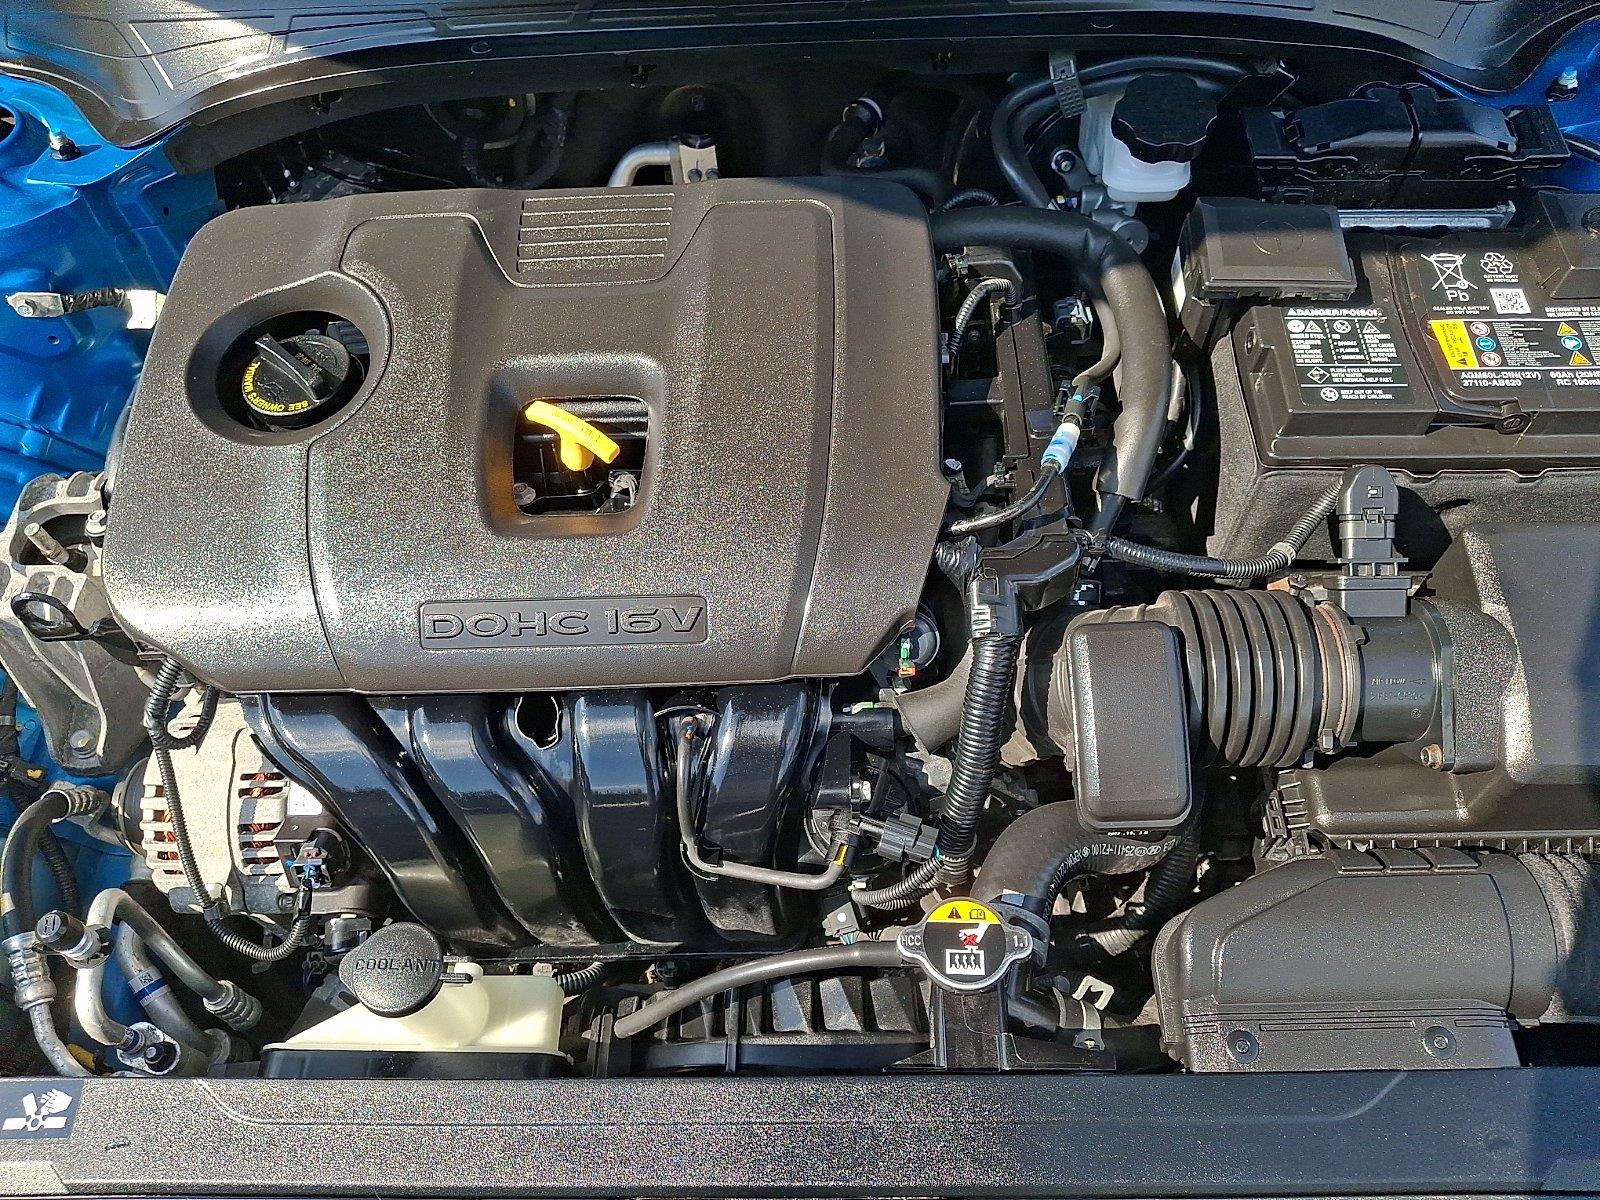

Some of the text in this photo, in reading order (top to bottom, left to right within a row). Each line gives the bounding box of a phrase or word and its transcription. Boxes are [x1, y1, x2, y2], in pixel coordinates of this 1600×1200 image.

[1446, 290, 1470, 302] Pb
[244, 361, 309, 412] SEE OWNER'S MANUAL
[1573, 378, 1600, 386] 100mi
[424, 606, 705, 639] DOHC 16V
[900, 934, 1029, 948] HCC 1.1
[355, 958, 441, 973] COOLANT
